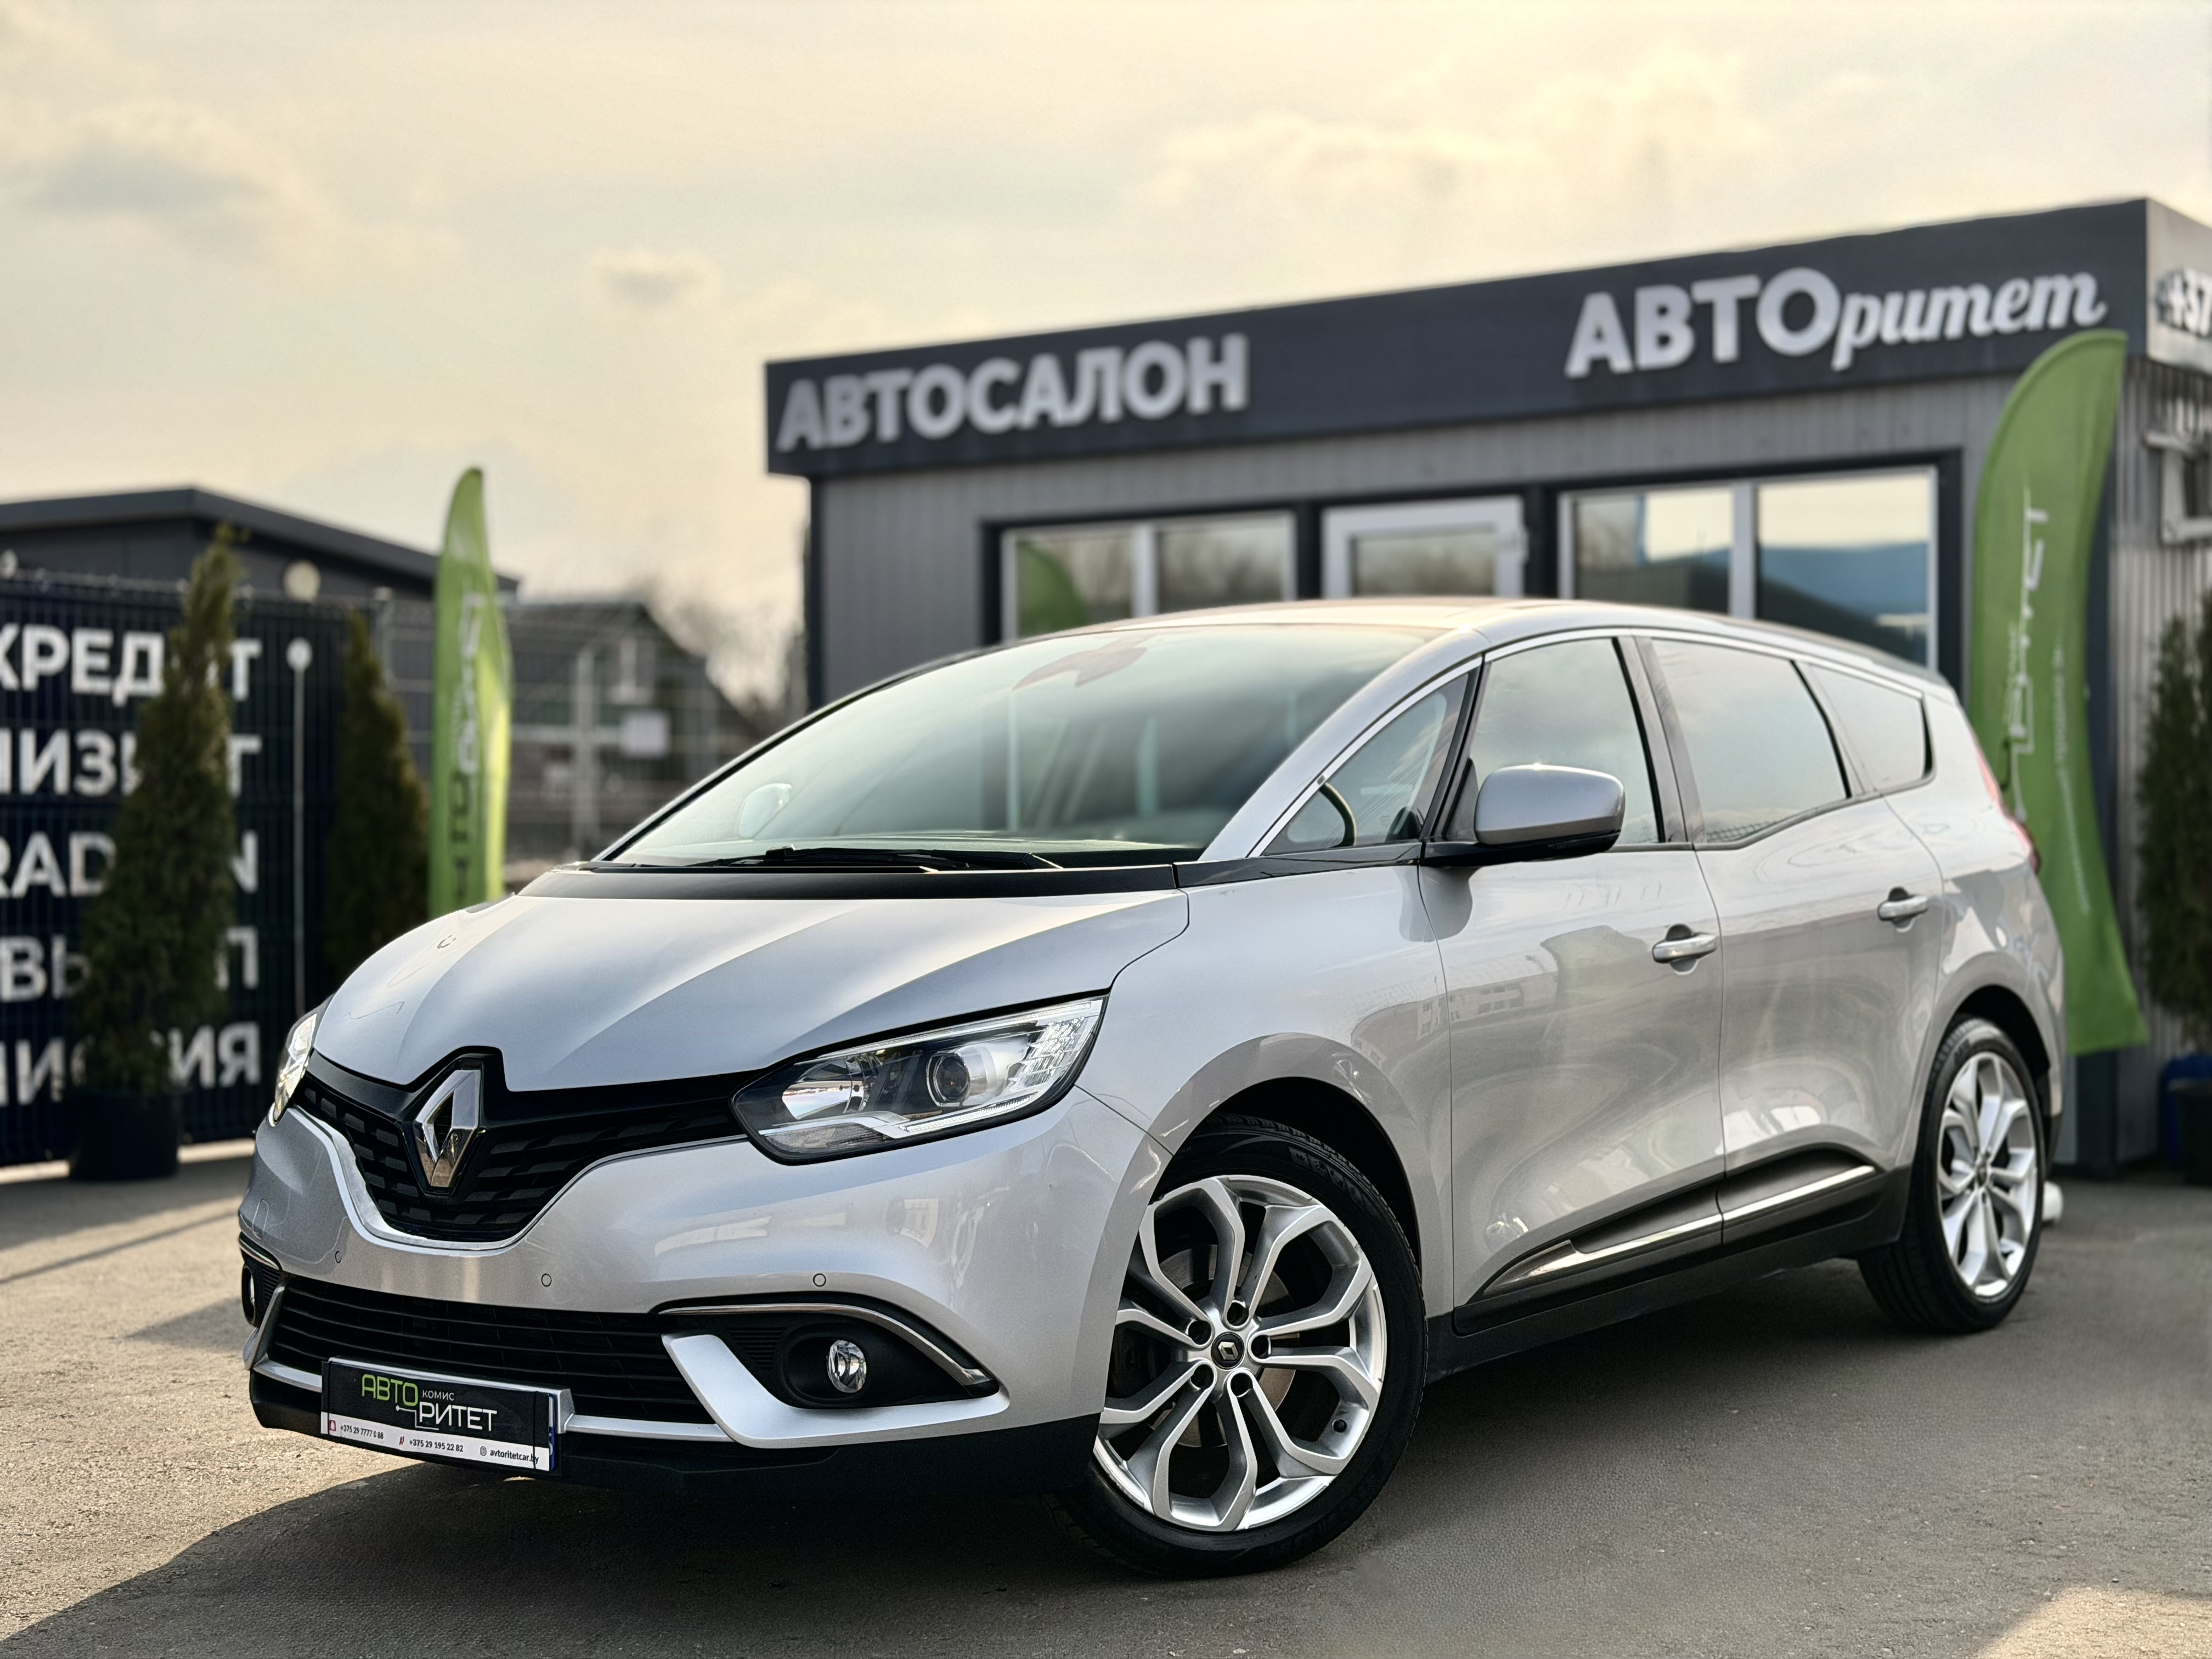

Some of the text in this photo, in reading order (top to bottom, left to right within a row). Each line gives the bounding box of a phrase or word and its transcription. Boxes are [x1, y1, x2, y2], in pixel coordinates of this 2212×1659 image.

[774, 332, 1249, 452] АВТОСАЛОН
[362, 1374, 419, 1407] АВТО
[419, 1401, 498, 1431] РИТЕТ
[340, 1424, 352, 1433] +375
[409, 1438, 424, 1447] +375
[434, 1441, 445, 1450] 195
[447, 1443, 455, 1451] 22
[455, 1444, 464, 1452] 82
[490, 1449, 539, 1464] avtoritetcar.by
